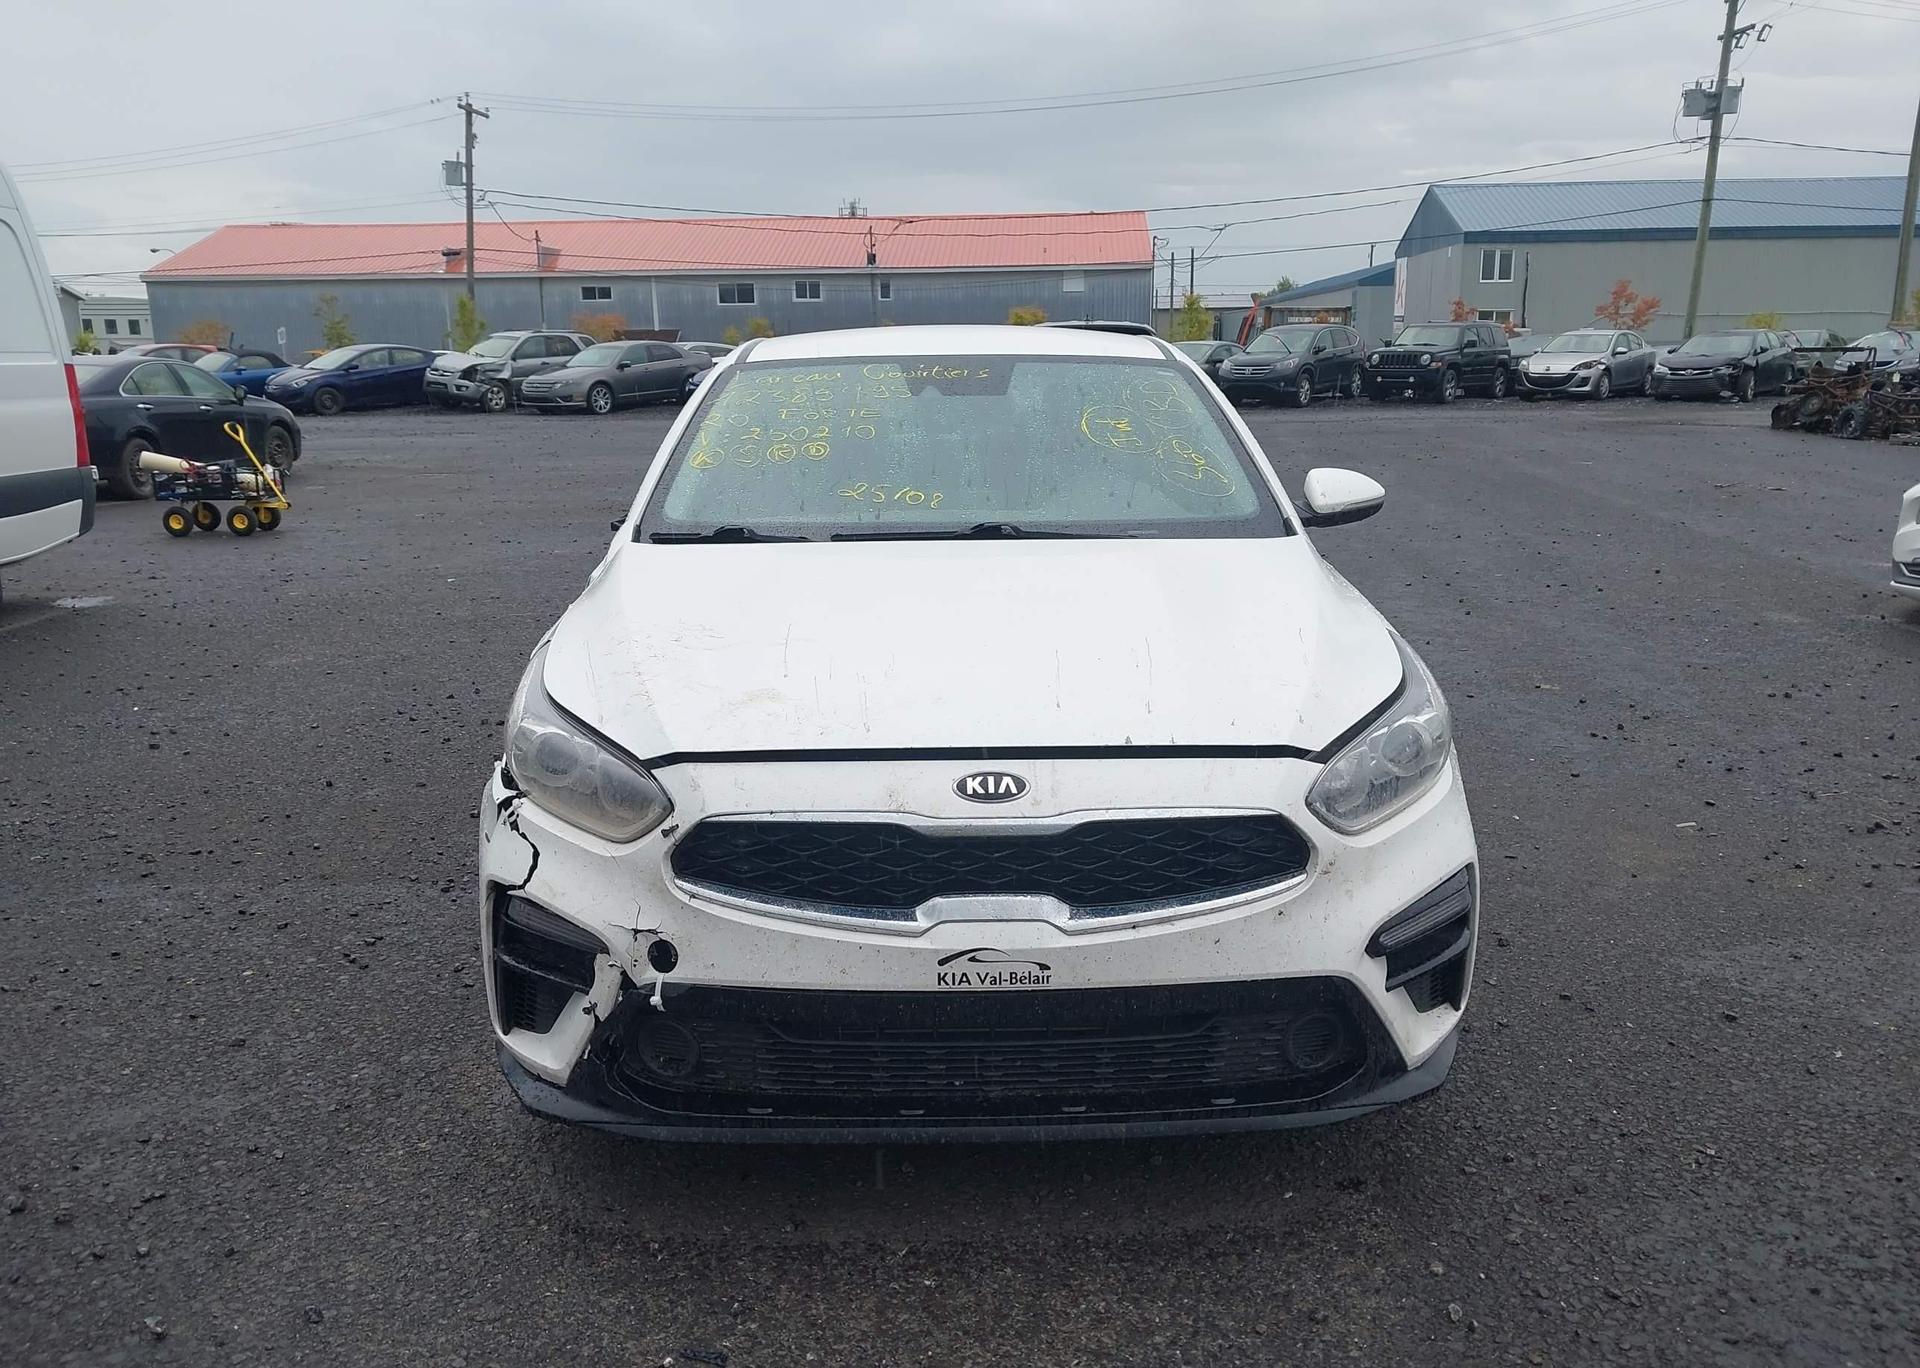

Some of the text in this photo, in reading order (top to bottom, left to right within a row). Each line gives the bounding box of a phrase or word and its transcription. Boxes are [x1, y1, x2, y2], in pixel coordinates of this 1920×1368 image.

[966, 775, 1018, 795] KIA
[937, 970, 1052, 986] KIA Val-Bélair
